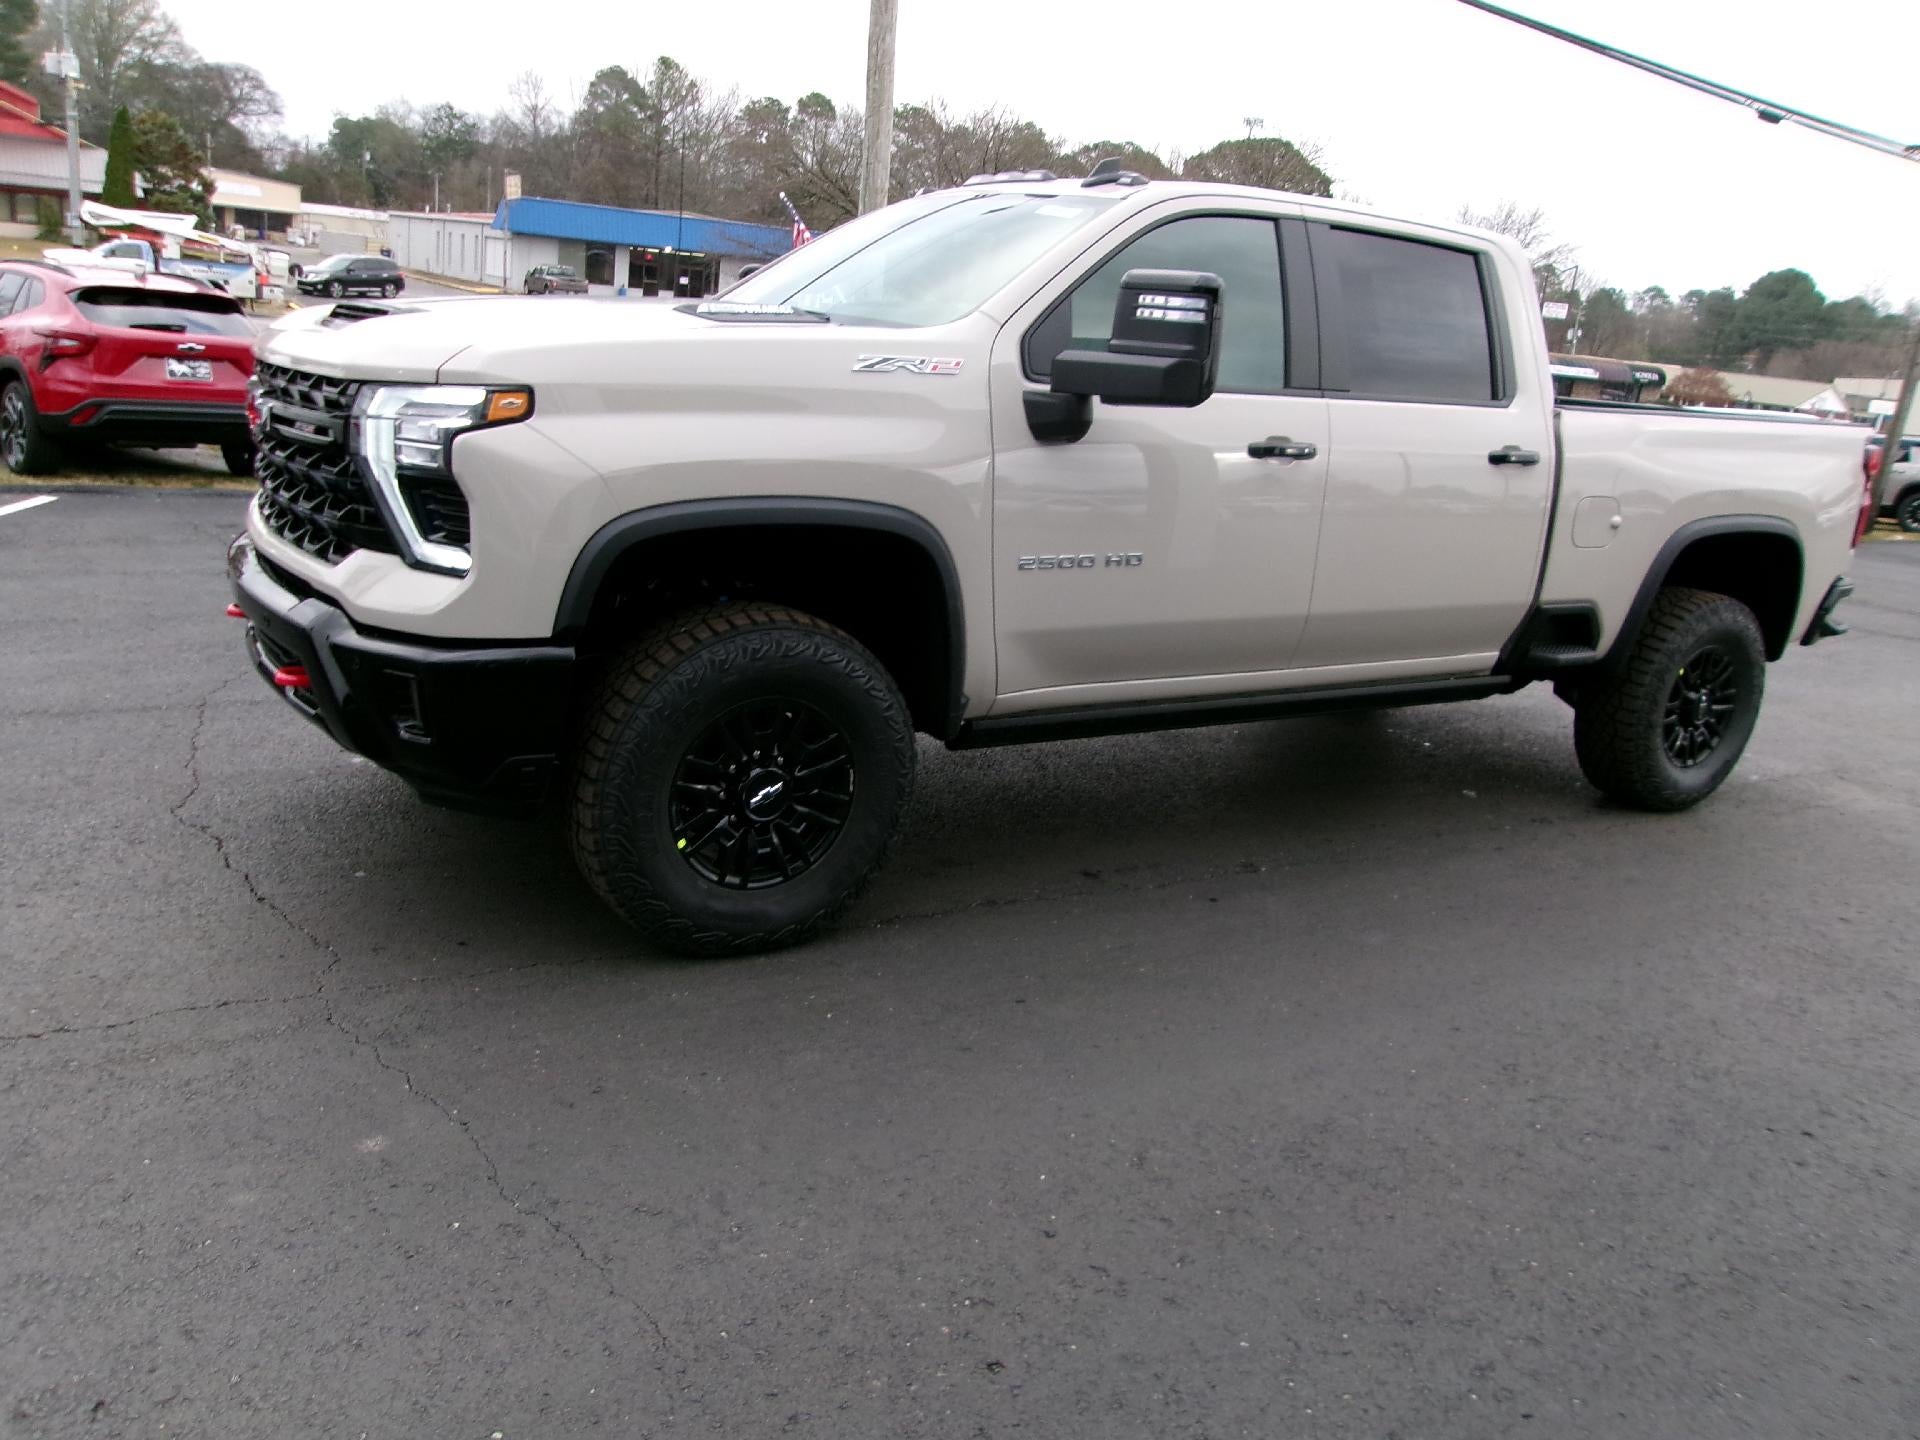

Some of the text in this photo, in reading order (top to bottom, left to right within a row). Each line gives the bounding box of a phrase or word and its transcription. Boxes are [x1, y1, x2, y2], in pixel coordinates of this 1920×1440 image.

[851, 354, 965, 375] ZR2
[1018, 552, 1144, 571] 2500 HD
